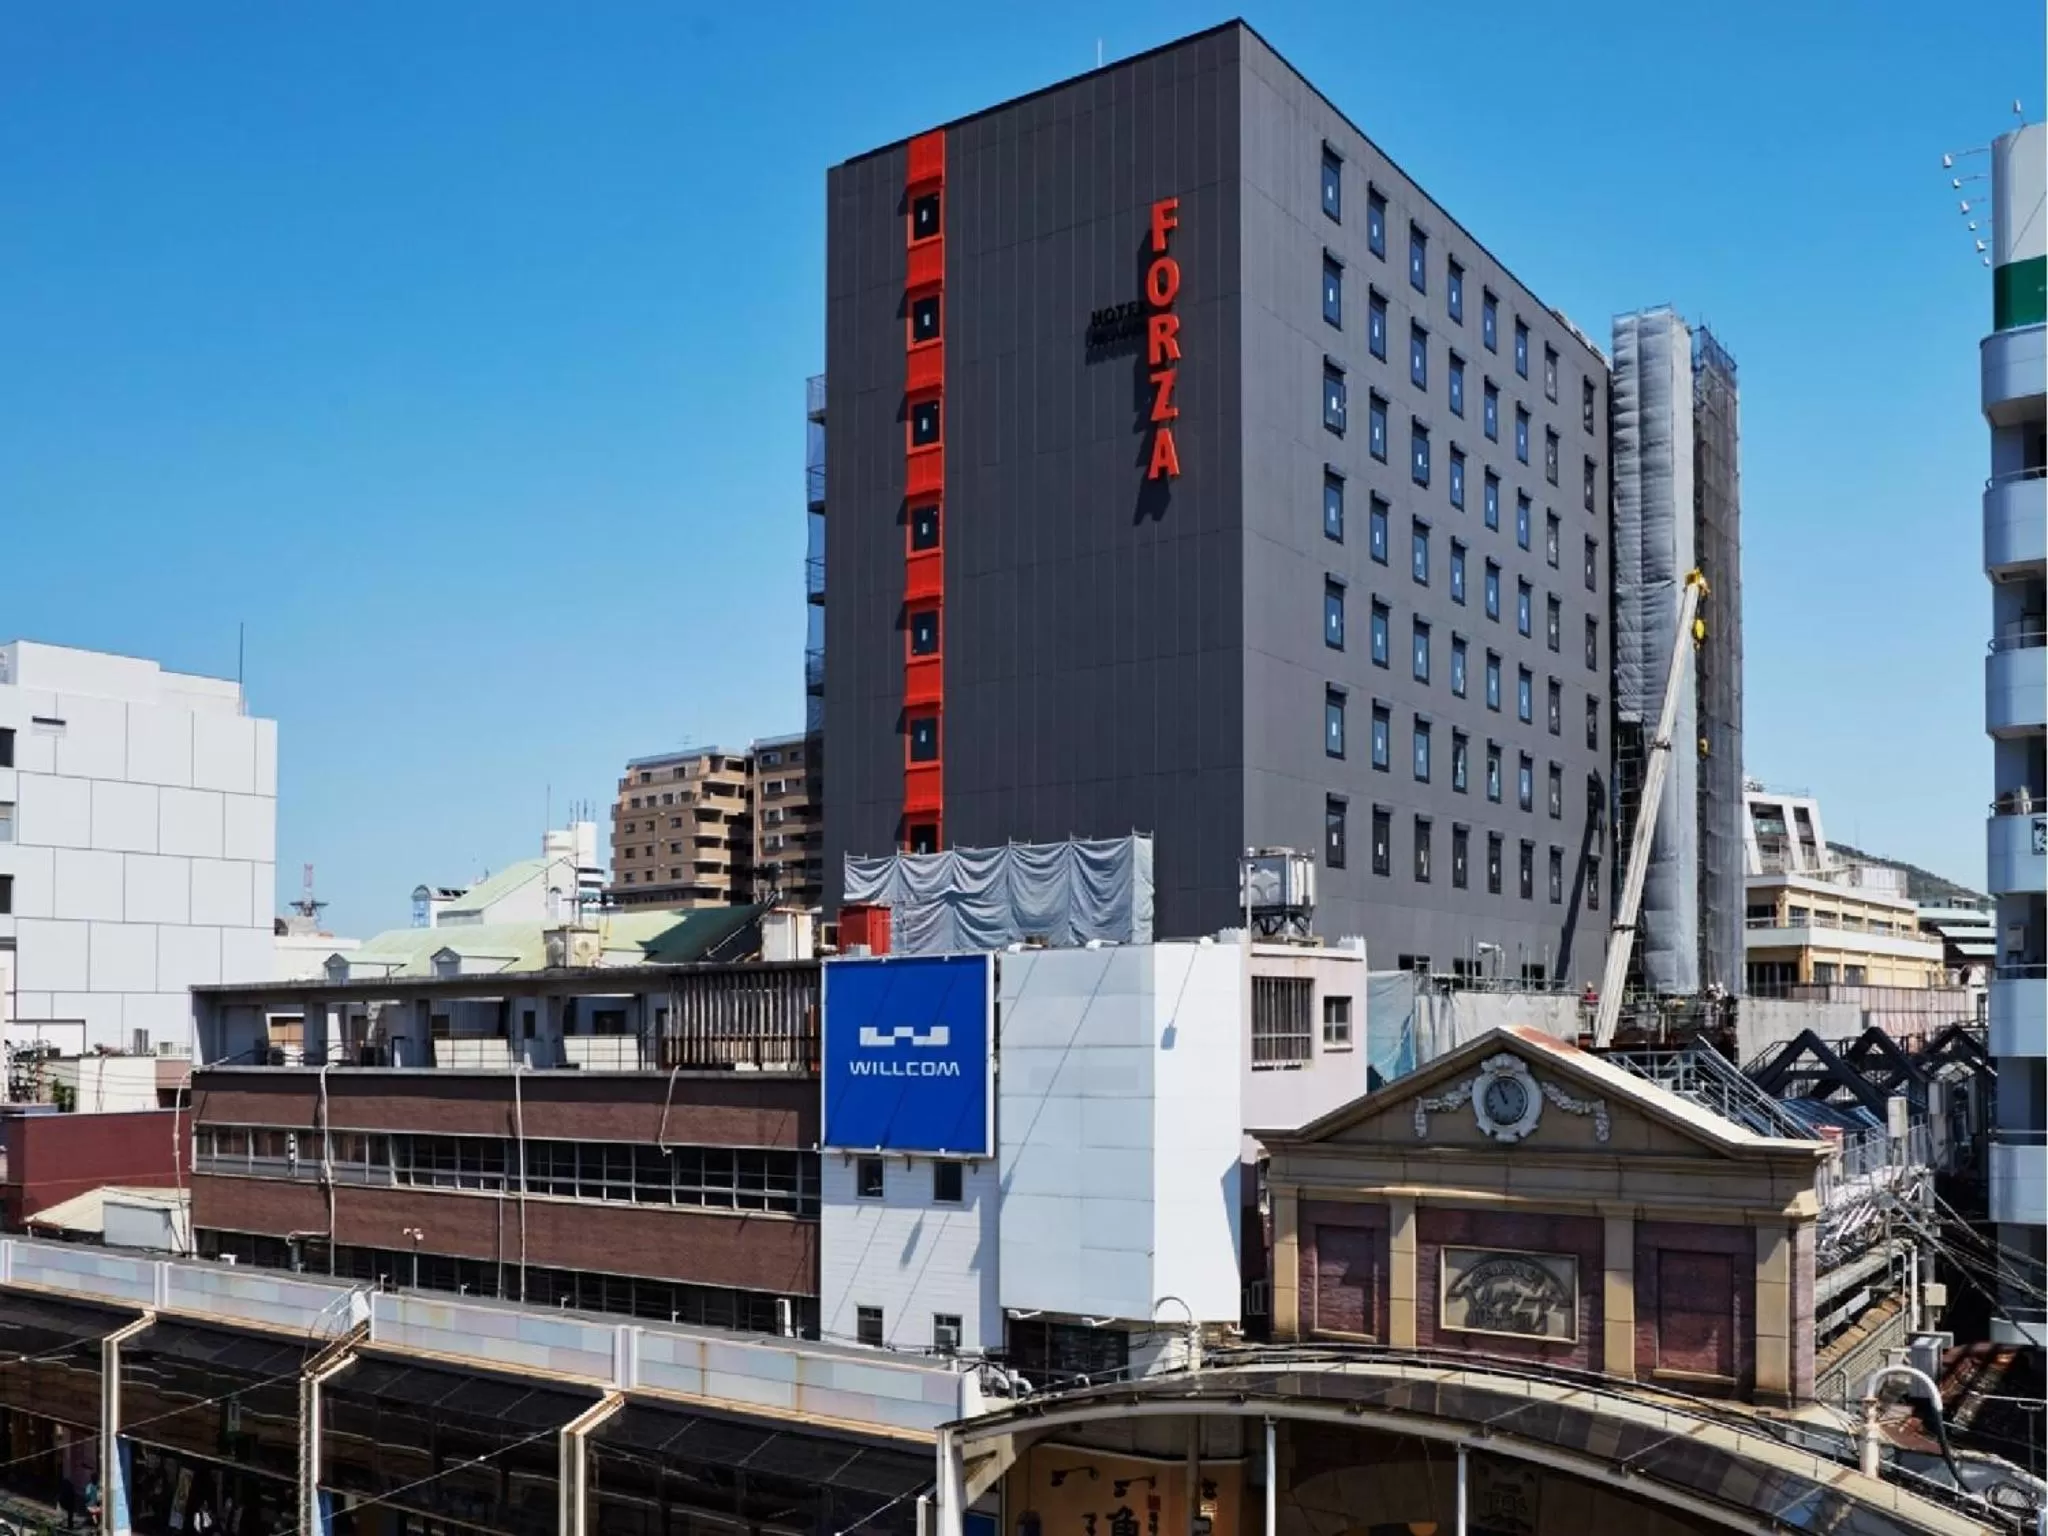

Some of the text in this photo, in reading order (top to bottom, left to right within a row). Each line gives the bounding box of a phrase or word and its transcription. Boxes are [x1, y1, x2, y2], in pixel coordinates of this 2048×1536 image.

[1092, 301, 1148, 327] HOTEL
[1145, 197, 1181, 480] FORZA
[849, 1061, 960, 1077] WILLCOM
